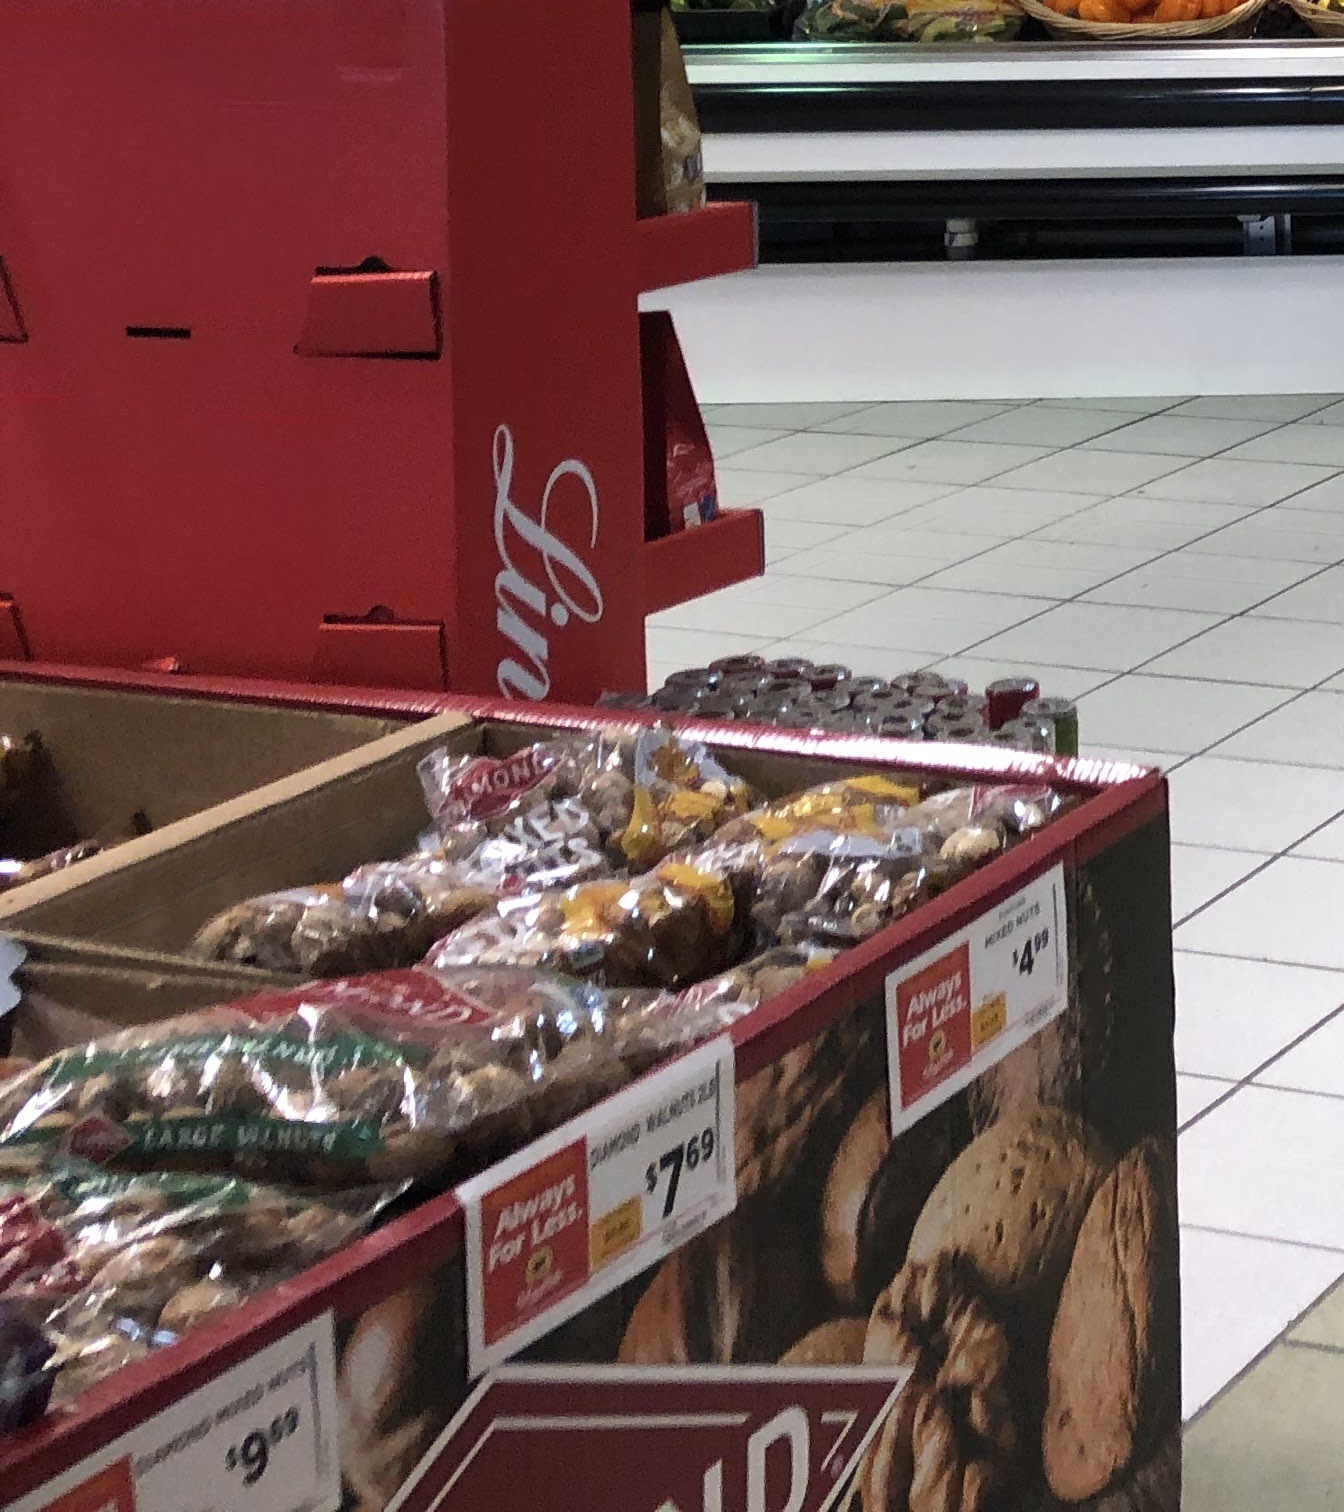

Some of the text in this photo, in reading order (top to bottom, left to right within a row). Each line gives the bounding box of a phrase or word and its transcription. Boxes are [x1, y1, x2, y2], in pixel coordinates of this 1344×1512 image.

[906, 972, 962, 1020] Always
[903, 1017, 927, 1048] For
[494, 1173, 577, 1240] Always
[489, 1232, 527, 1274] For
